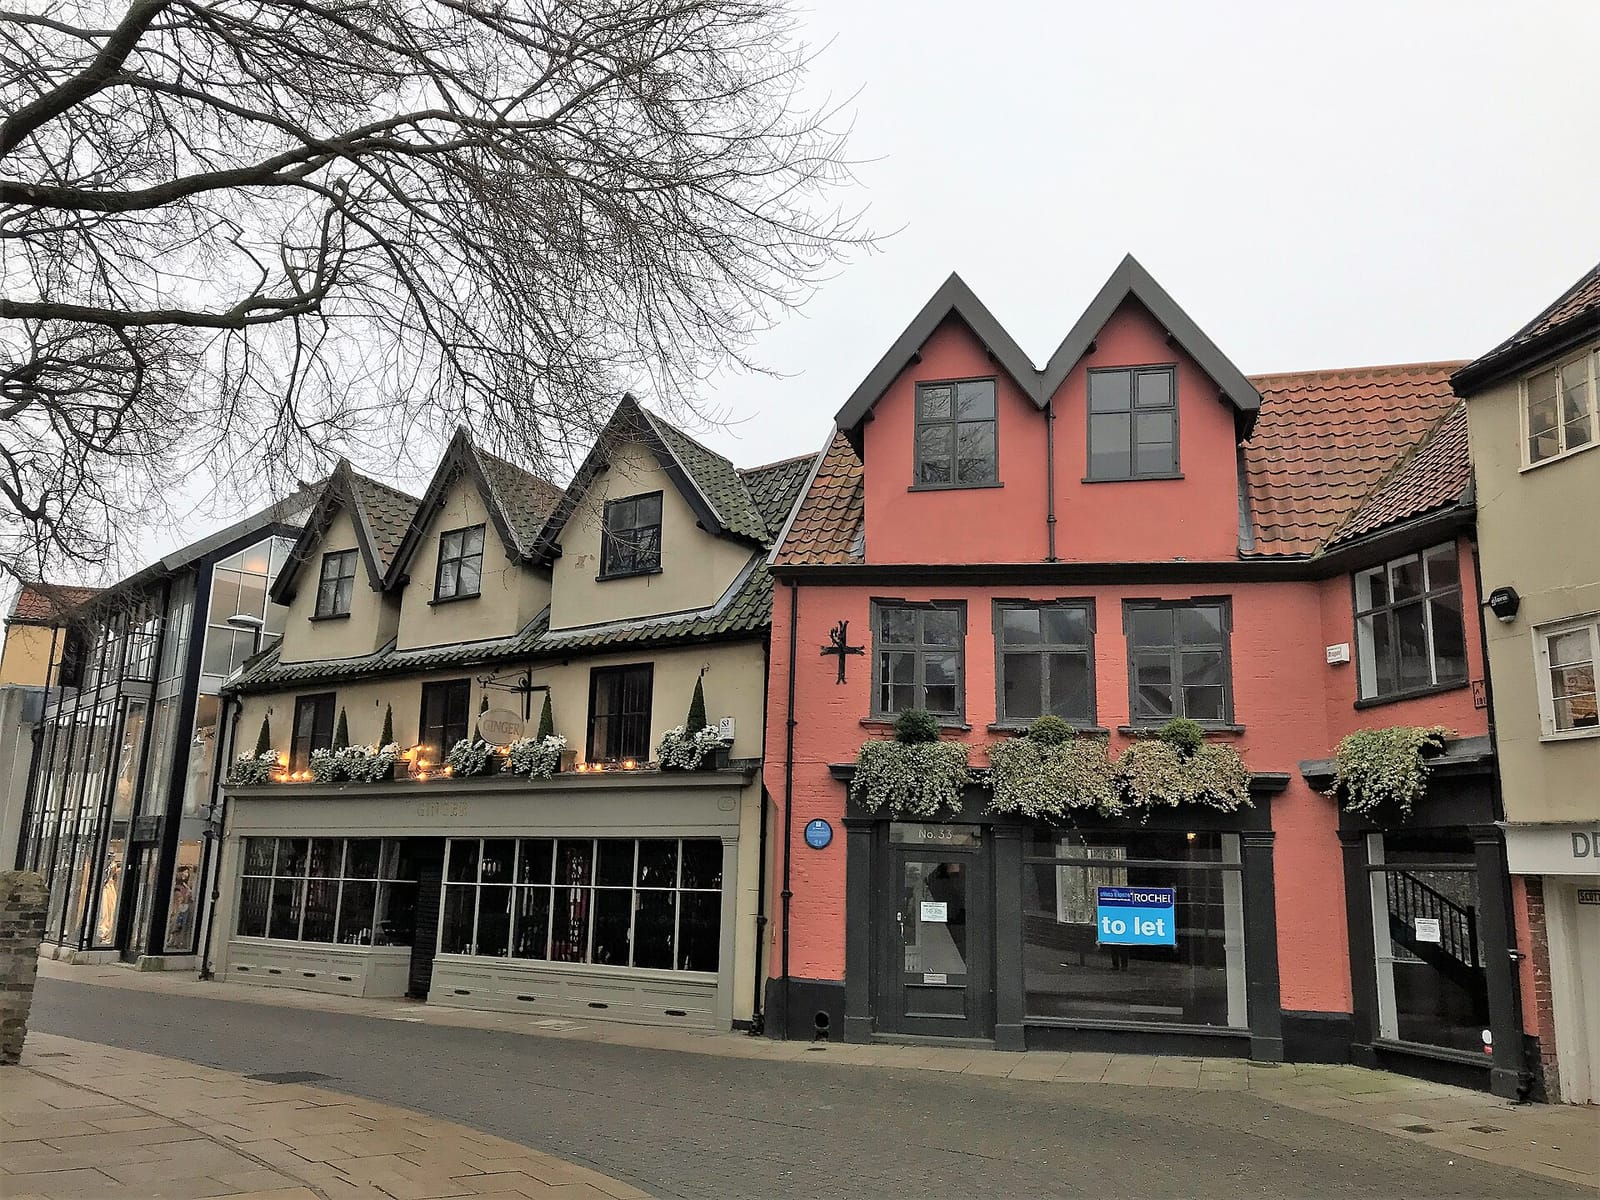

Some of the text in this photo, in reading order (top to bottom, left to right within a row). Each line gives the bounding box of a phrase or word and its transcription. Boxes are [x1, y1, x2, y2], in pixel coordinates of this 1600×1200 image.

[483, 719, 520, 736] GINGER
[1101, 916, 1166, 937] to let
